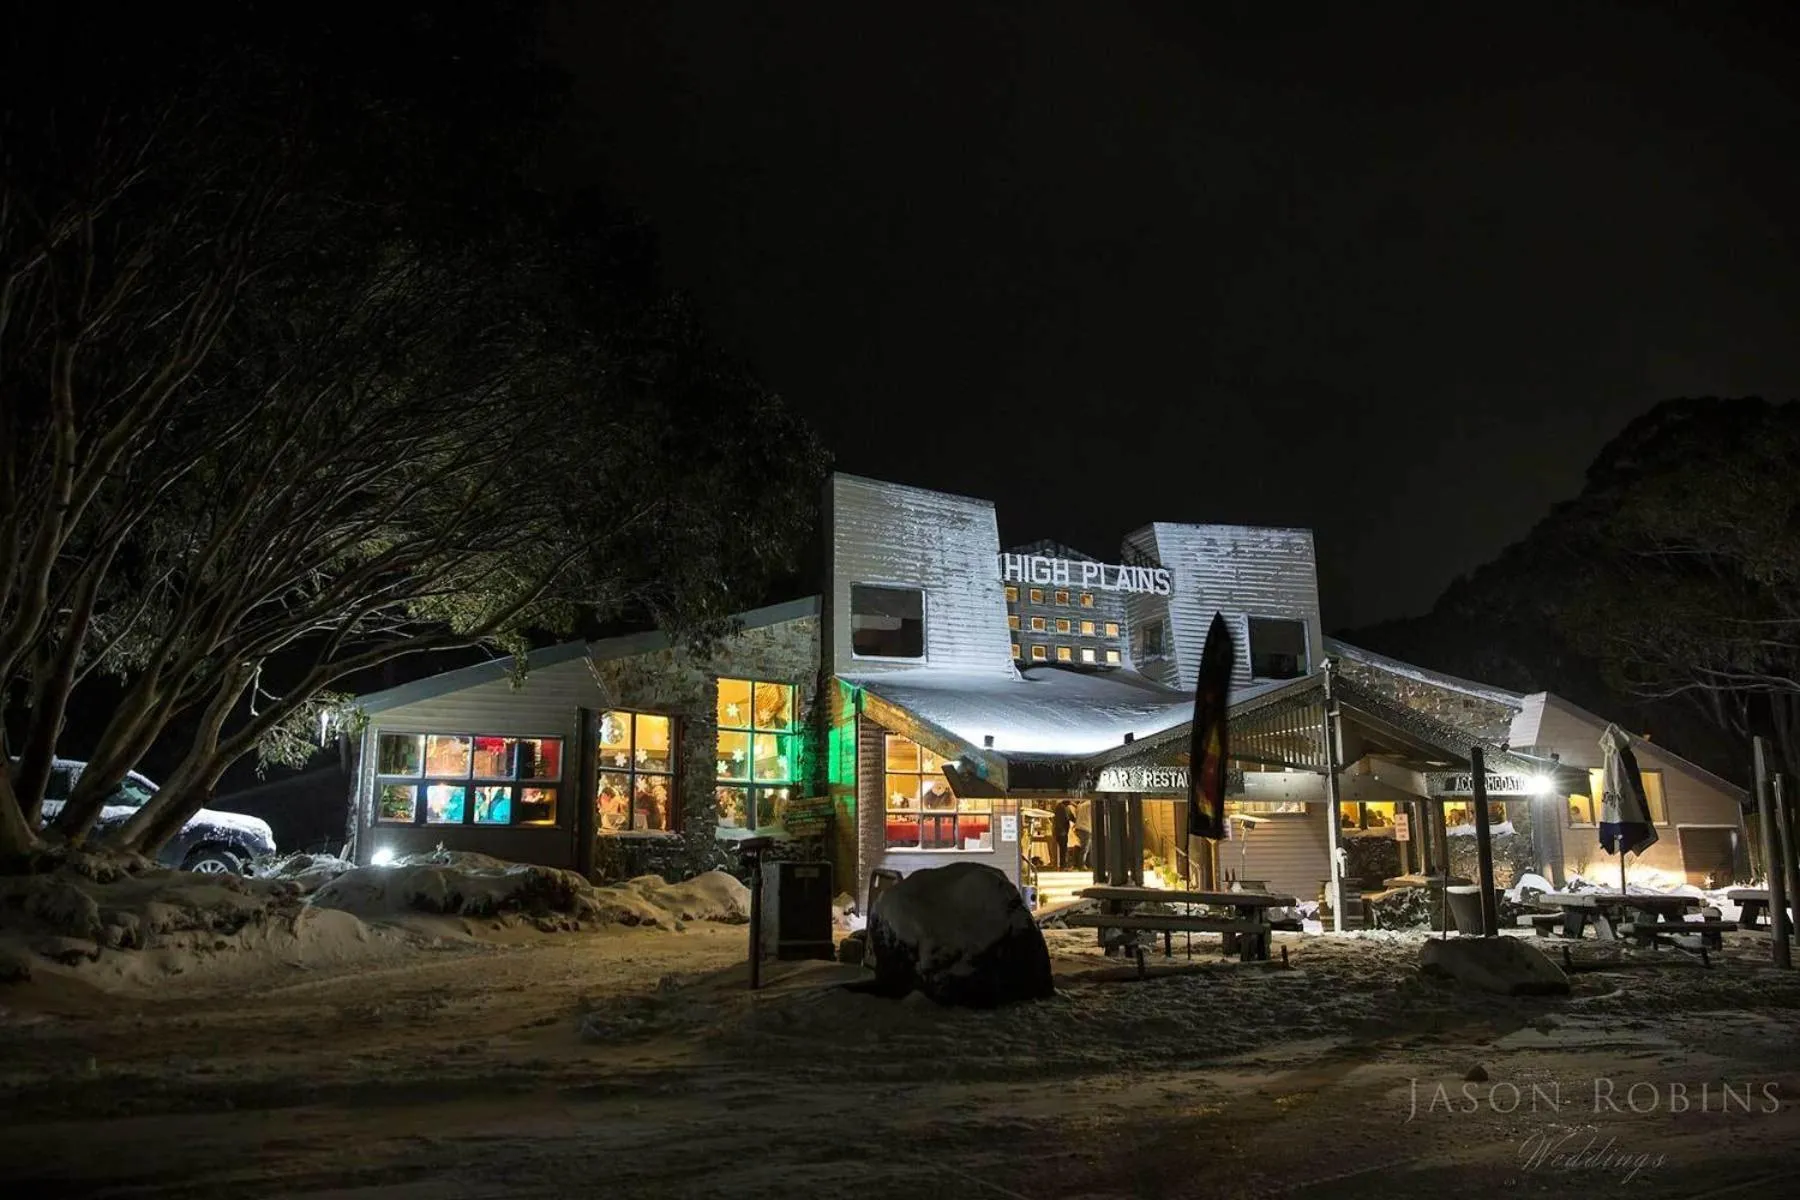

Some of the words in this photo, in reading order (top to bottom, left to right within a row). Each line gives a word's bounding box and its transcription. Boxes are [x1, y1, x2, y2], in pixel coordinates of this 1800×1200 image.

[1003, 553, 1069, 586] HIGH
[1081, 560, 1171, 596] PLAINS
[1100, 769, 1129, 789] BAR
